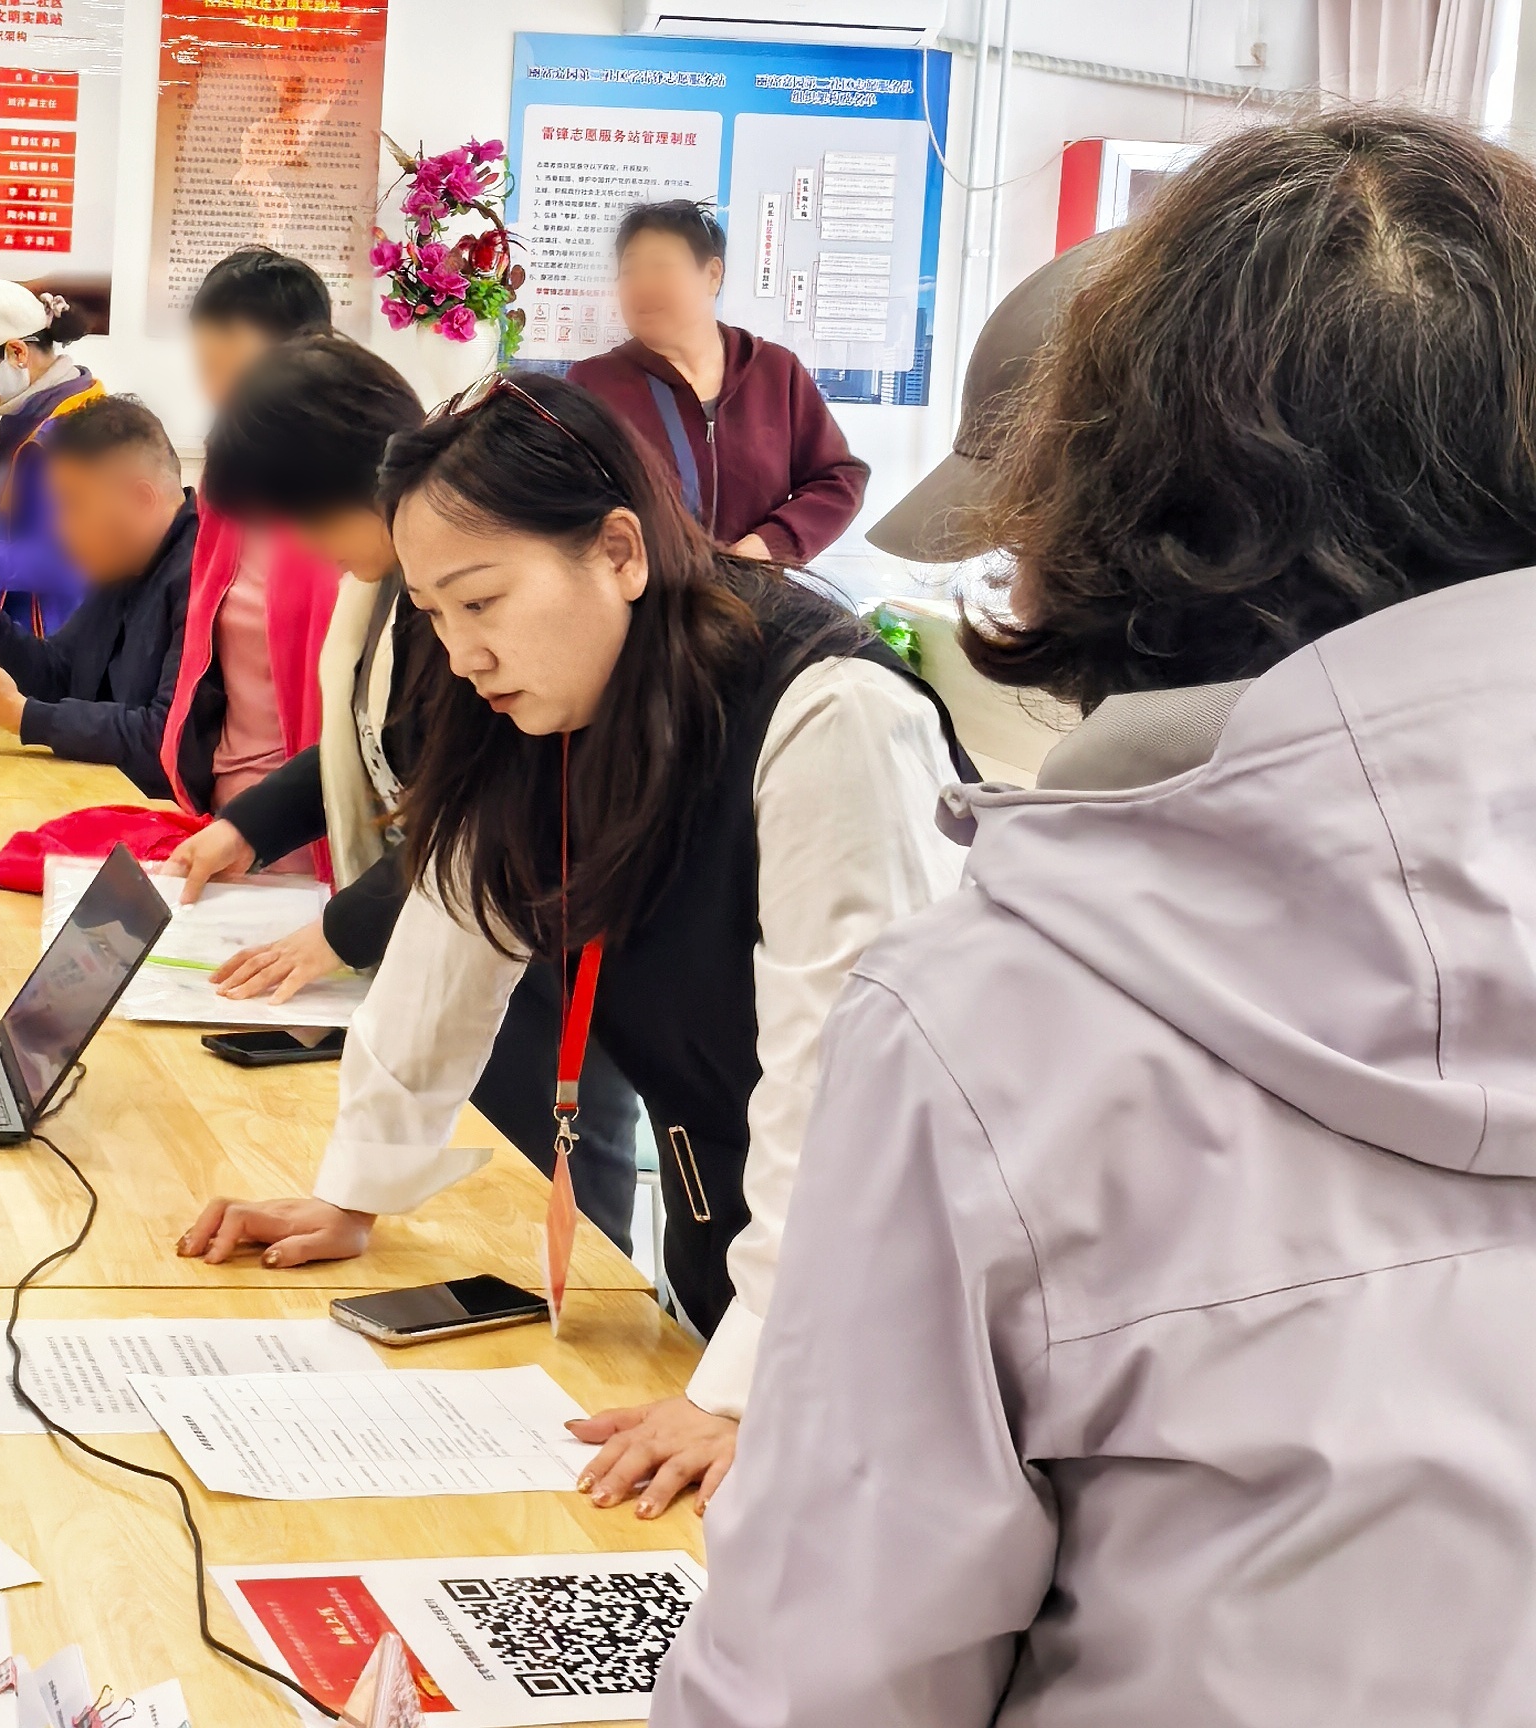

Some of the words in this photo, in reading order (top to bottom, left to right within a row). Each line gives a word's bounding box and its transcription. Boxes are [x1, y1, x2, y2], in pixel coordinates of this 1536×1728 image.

[542, 126, 698, 146] 雷锋志愿服务站管理制度
